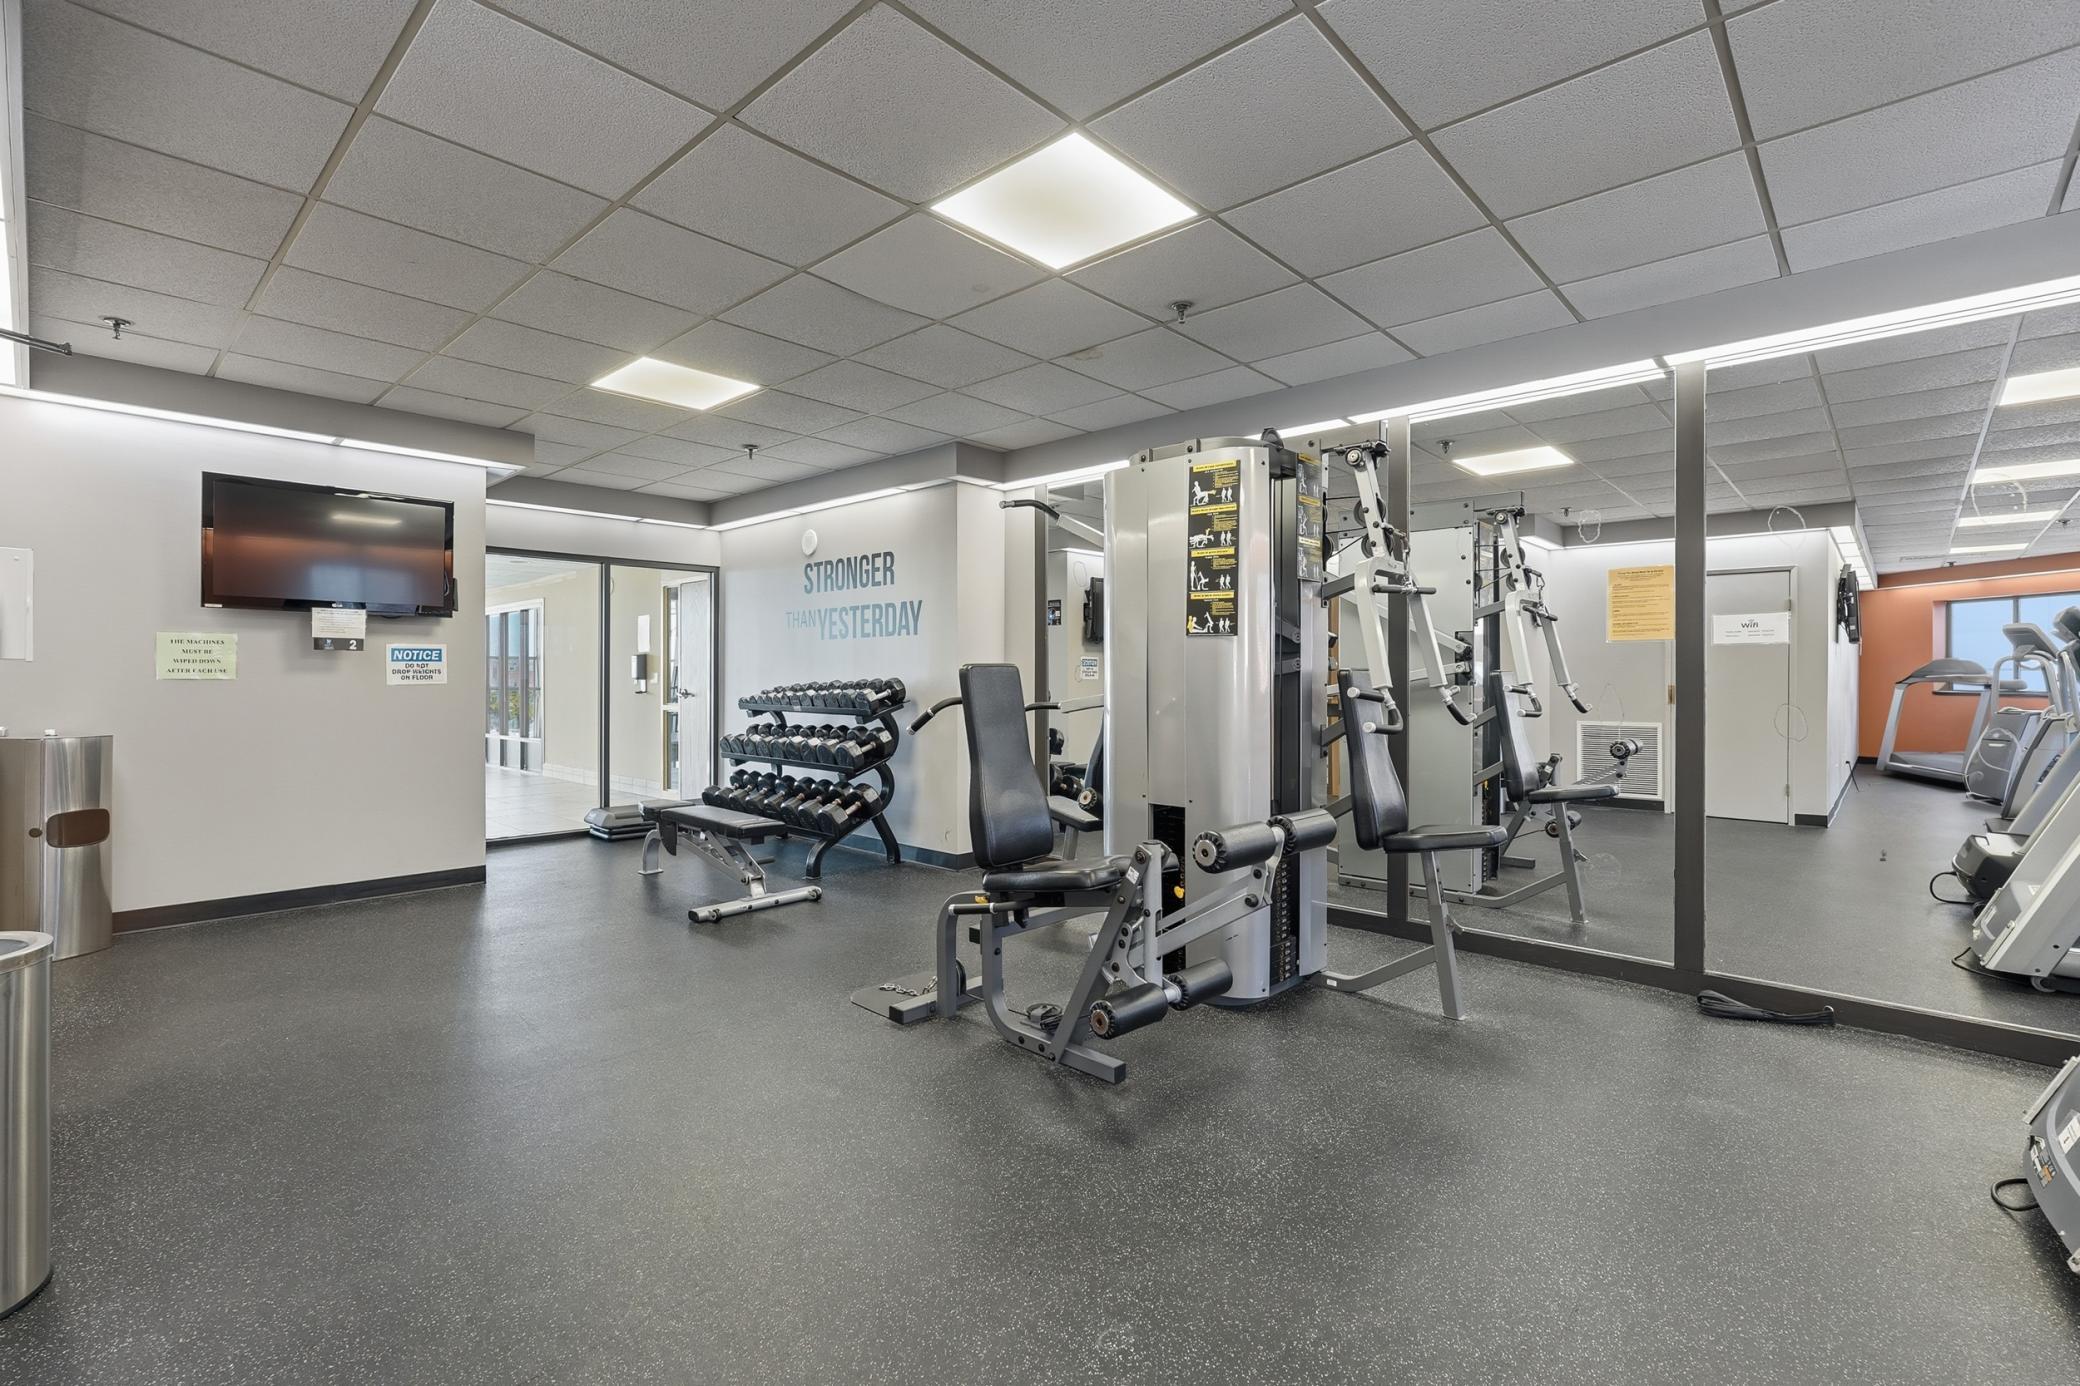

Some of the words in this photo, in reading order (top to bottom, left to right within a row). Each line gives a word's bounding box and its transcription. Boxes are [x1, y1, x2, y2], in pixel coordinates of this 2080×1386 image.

[804, 551, 895, 594] STRONGER
[785, 609, 816, 629] THAN
[817, 600, 923, 640] YESTERDAY
[349, 640, 357, 650] 2
[393, 650, 440, 660] NOTICE
